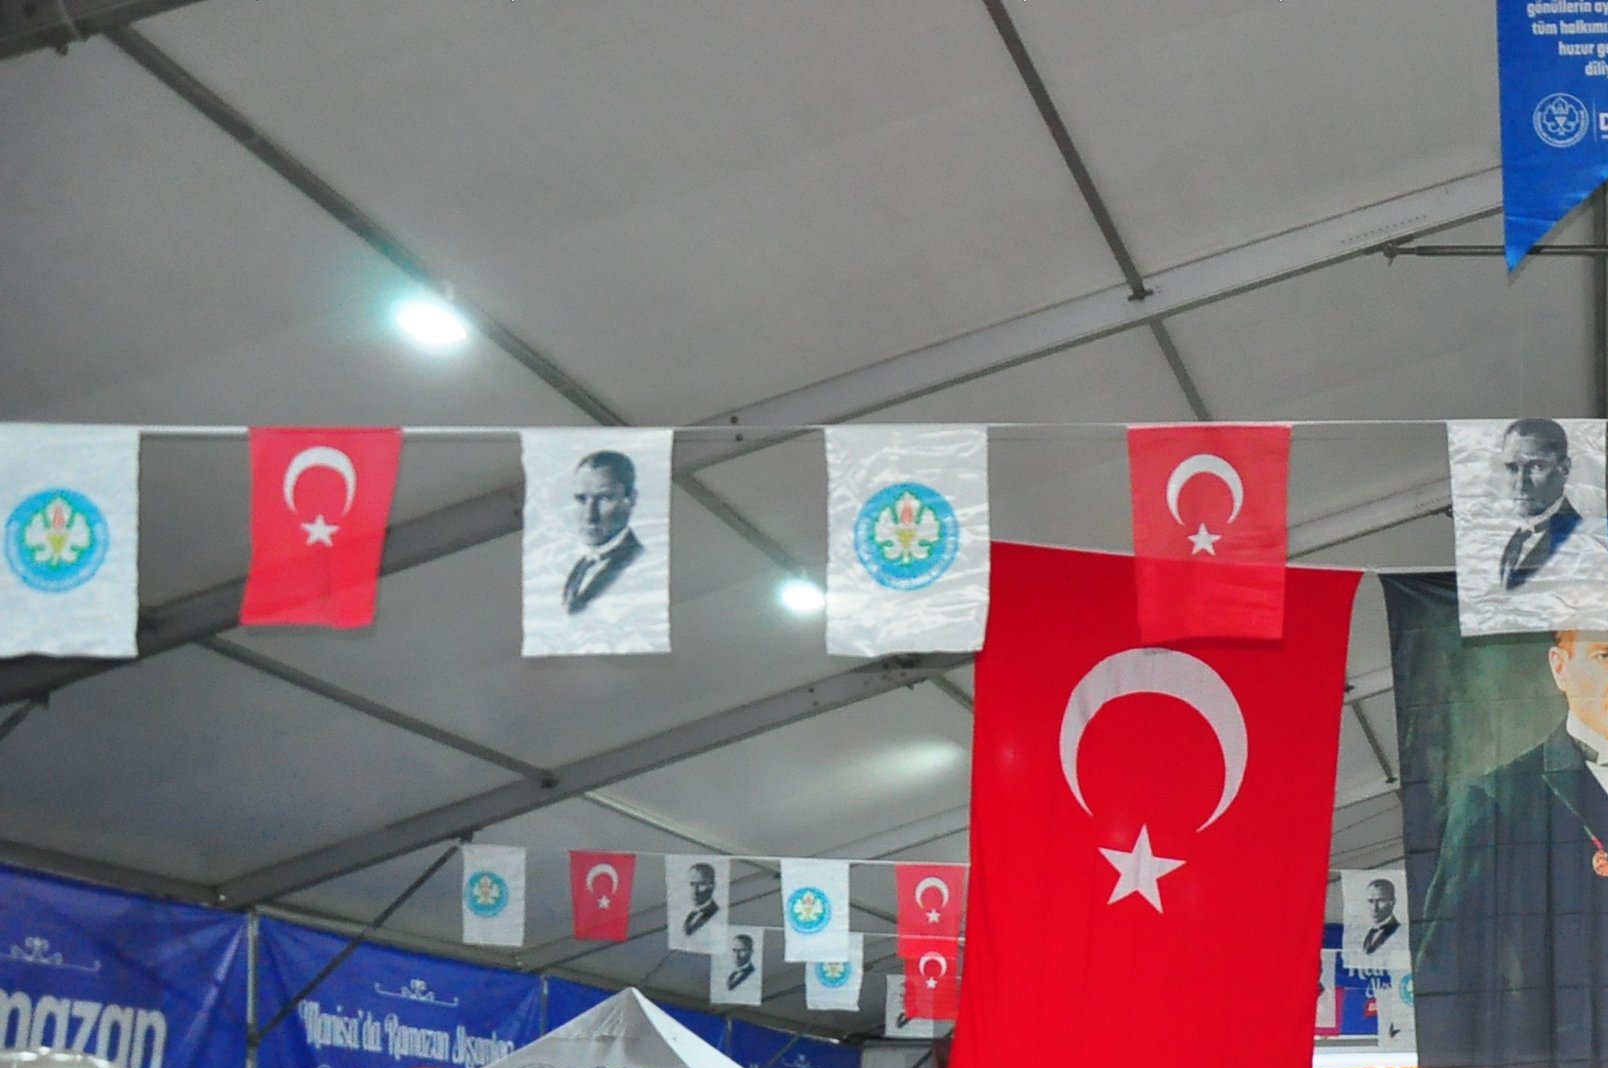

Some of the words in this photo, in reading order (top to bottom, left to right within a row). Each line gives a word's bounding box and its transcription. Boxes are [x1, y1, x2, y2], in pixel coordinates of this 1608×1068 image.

[1532, 21, 1557, 35] tüm
[1558, 41, 1595, 56] huzur
[299, 999, 382, 1052] Manisa'da
[384, 1013, 449, 1061] Ramazan
